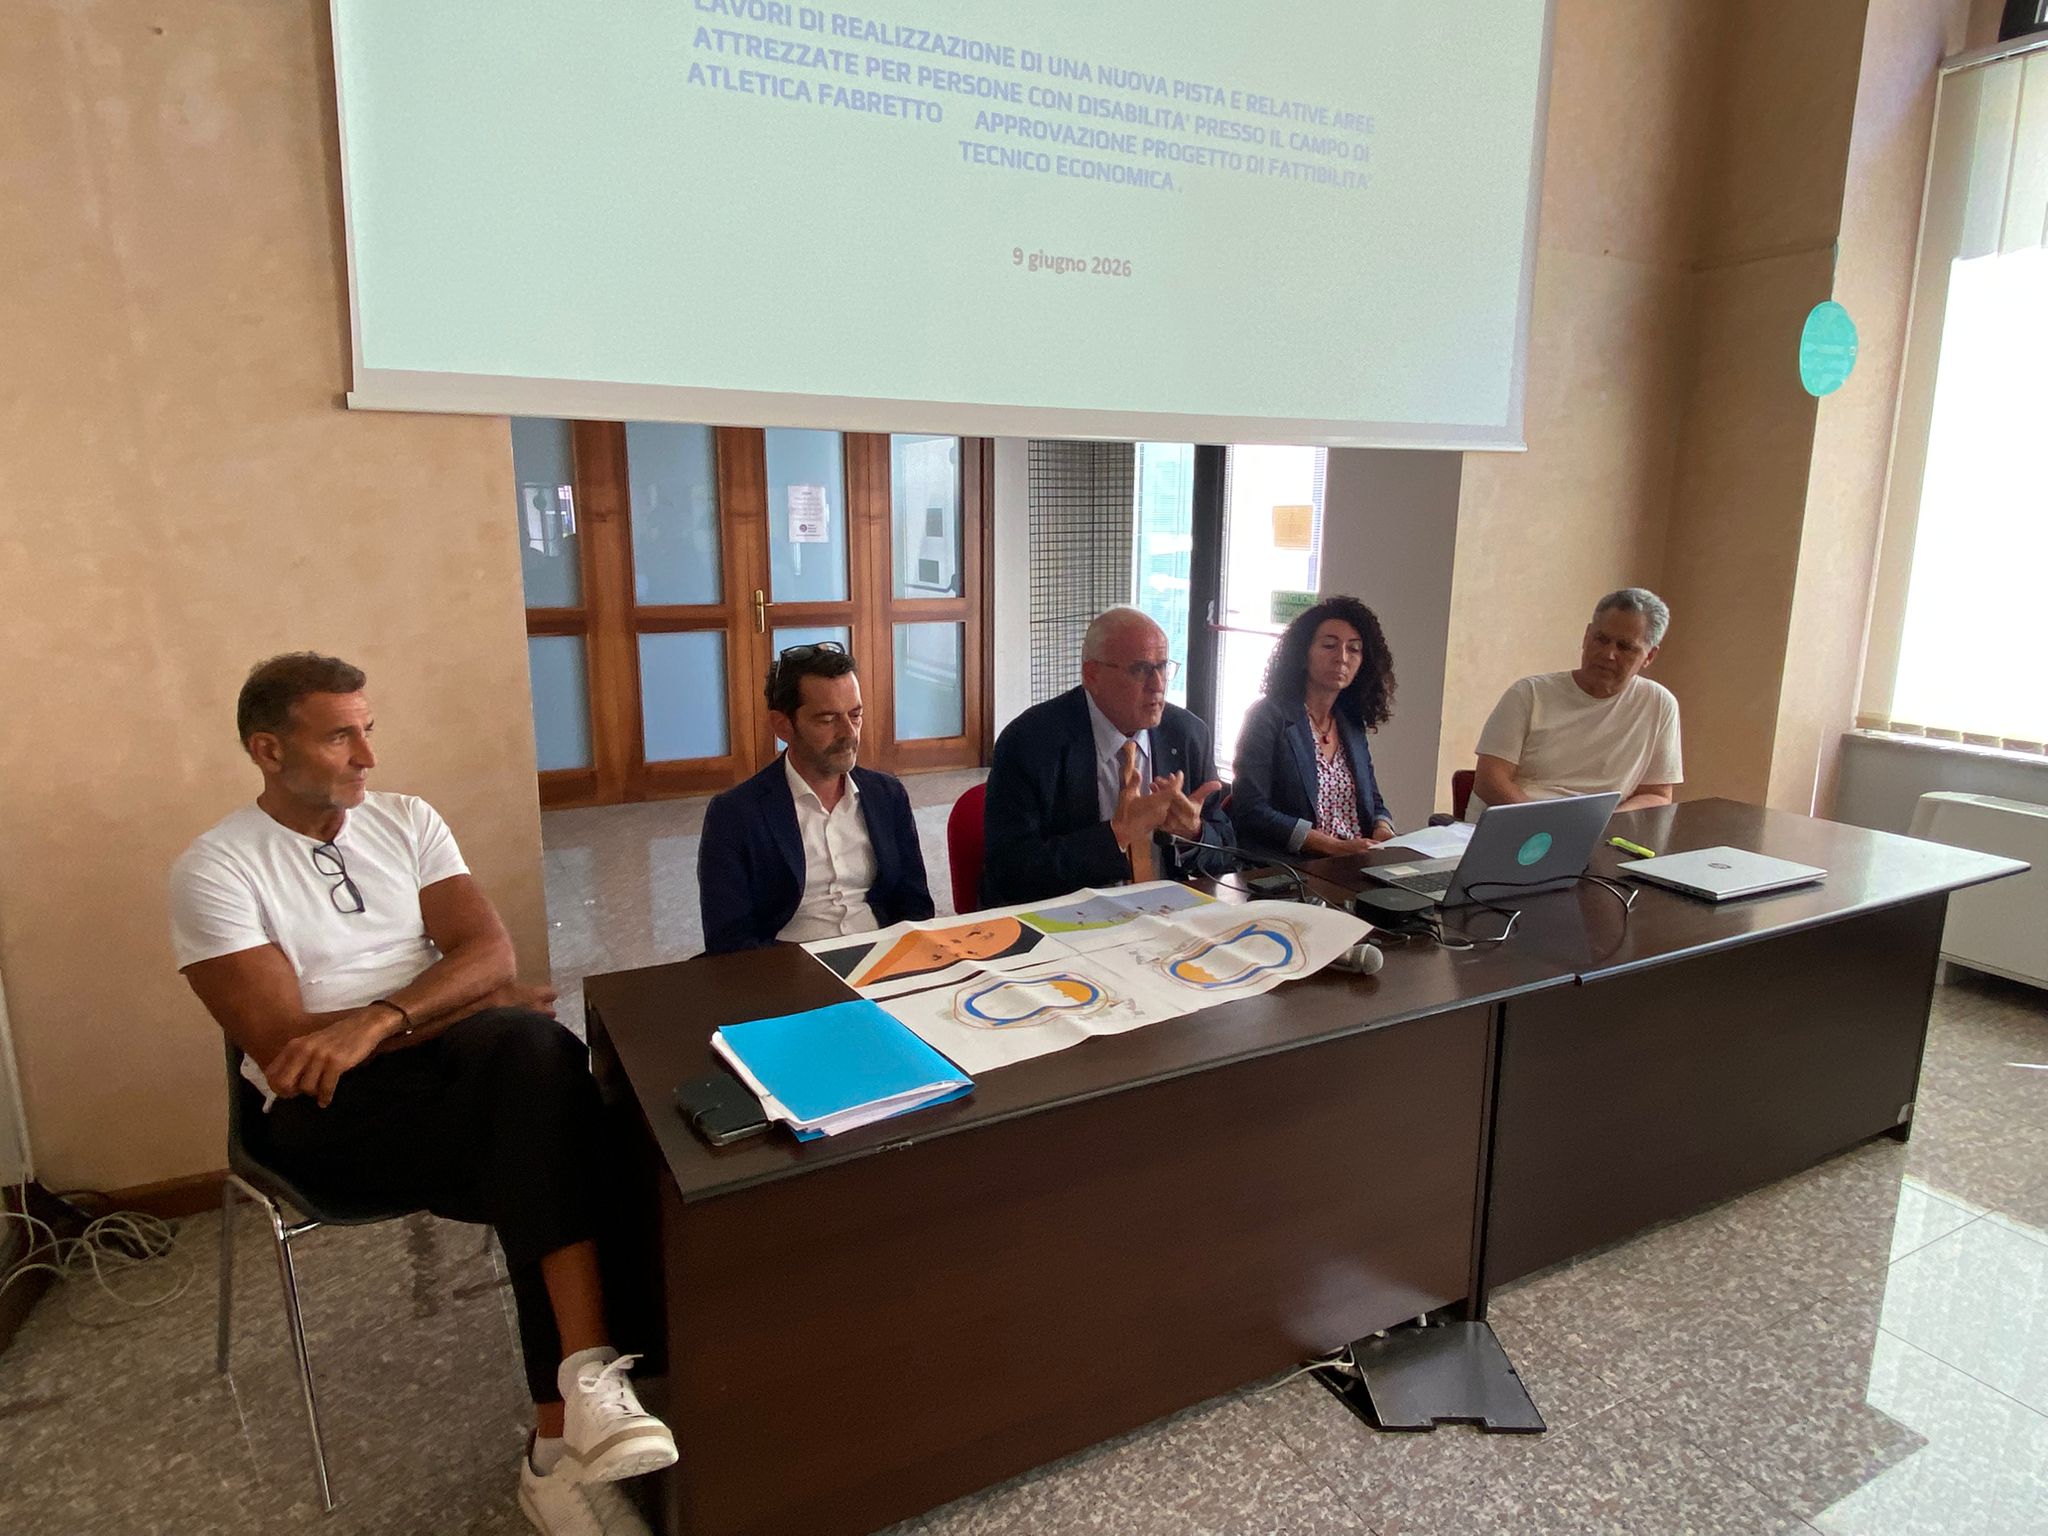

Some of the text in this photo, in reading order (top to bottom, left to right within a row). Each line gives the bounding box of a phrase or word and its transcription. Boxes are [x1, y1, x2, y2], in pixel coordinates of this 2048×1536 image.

[687, 62, 812, 103] ATLETICA
[818, 83, 943, 123] FABRETTO
[975, 110, 1137, 155] APPROVAZIONE
[1142, 137, 1242, 171] PROGETTO
[1246, 155, 1264, 175] DI
[693, 26, 1370, 163] ATTREZZATE PER PERSONE CON DISABILITA' PRESSO IL CAMPO DI
[800, 8, 824, 32] DI
[832, 14, 1015, 68] REALIZZAZIONE
[1021, 50, 1042, 73] DI
[1048, 56, 1092, 82] UNA
[1098, 65, 1168, 97] NUOVA
[1173, 80, 1226, 107] PISTA
[1230, 91, 1242, 110] E
[1246, 94, 1329, 127] RELATIVE
[1332, 111, 1376, 135] AREE
[958, 140, 1051, 173] TECNICO
[1012, 247, 1132, 277] 9 giugno 2026
